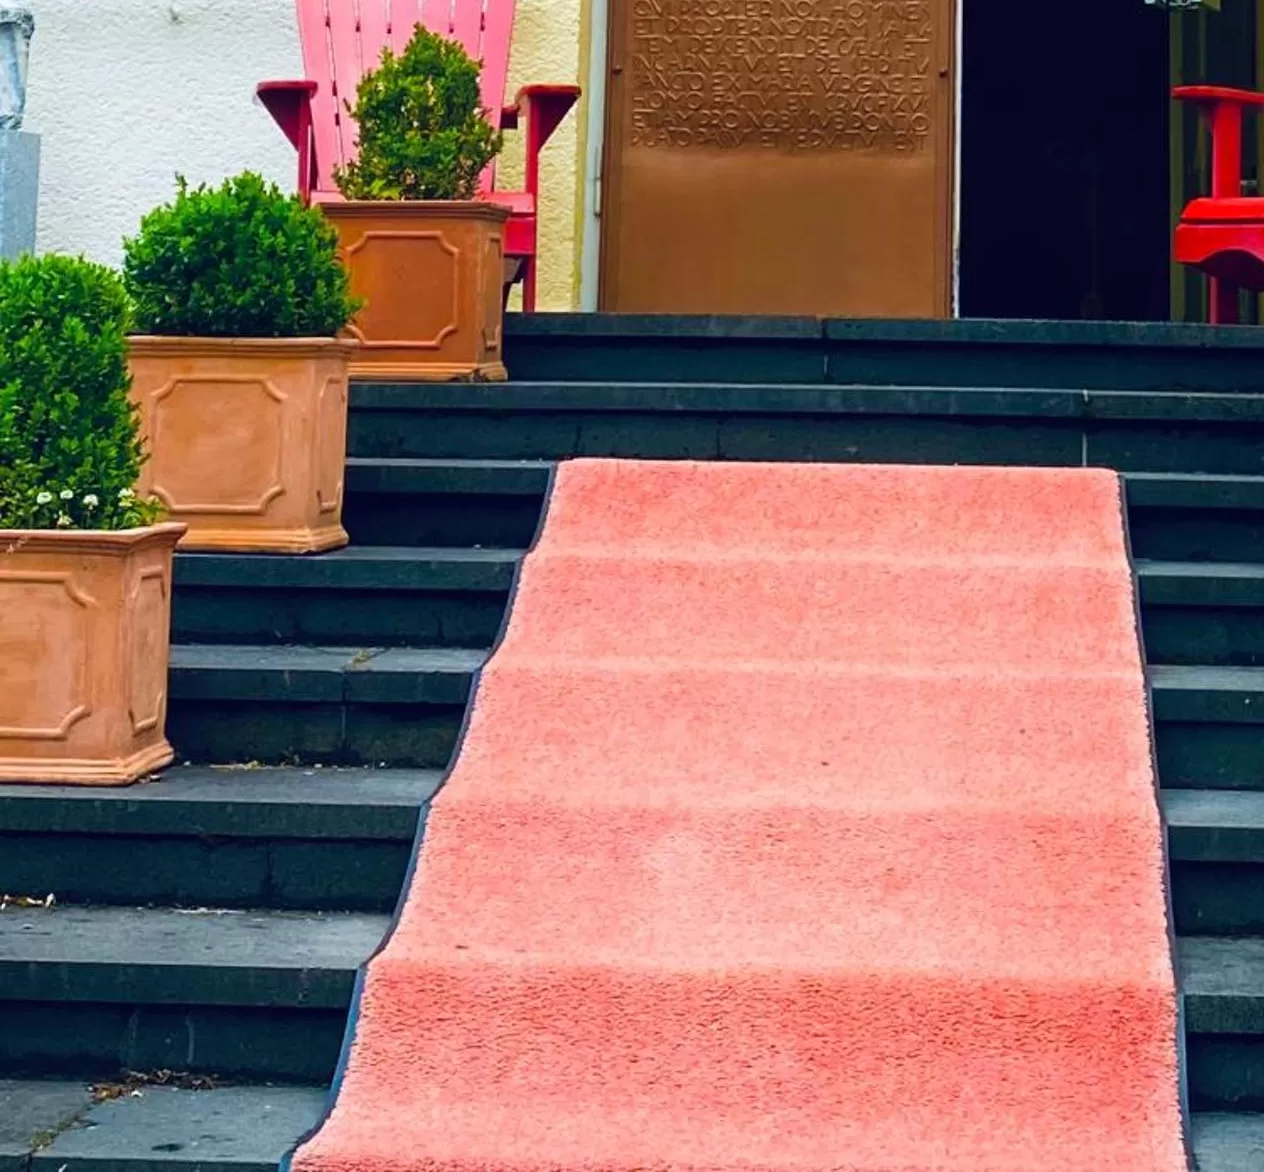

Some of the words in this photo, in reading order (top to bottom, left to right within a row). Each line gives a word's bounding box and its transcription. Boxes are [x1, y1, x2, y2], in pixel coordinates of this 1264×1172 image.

[634, 16, 663, 34] ET
[807, 36, 831, 55] DE
[903, 39, 931, 58] ET
[815, 55, 841, 74] DE
[711, 71, 741, 91] EX
[633, 90, 705, 110] HOMO
